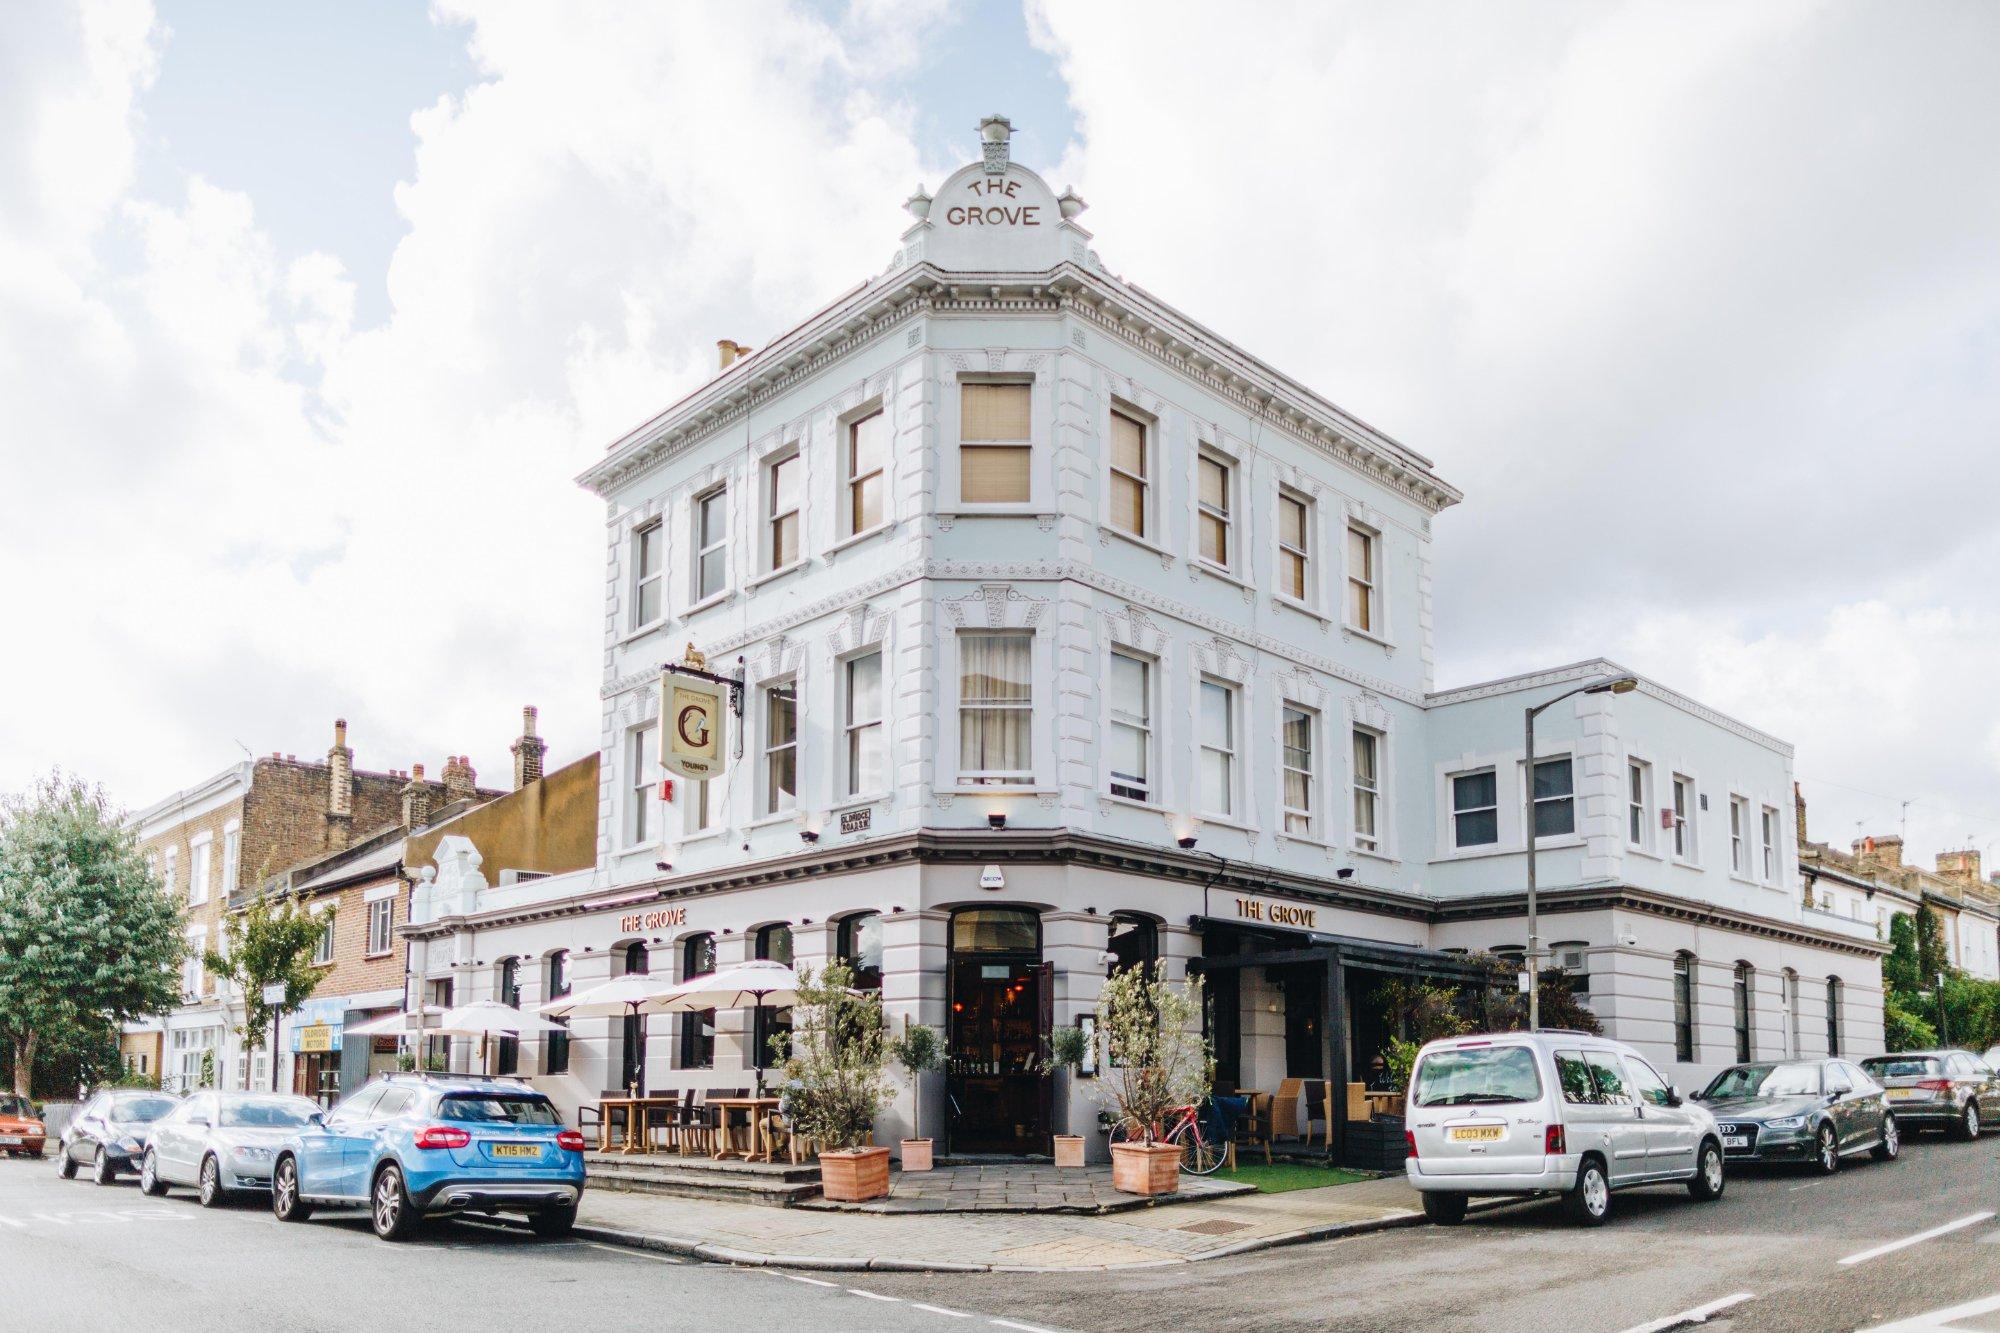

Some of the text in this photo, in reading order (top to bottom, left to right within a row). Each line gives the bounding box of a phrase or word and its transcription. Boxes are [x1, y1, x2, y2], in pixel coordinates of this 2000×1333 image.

[967, 178, 1022, 199] THE
[946, 206, 1040, 226] GROVE
[678, 705, 709, 747] G
[681, 759, 709, 771] YOUNG'S
[618, 907, 686, 933] THE GROVE
[1235, 898, 1317, 928] THE GROVE
[1455, 1128, 1499, 1139] LC03 MXW
[496, 1145, 538, 1156] KT15 HMZ
